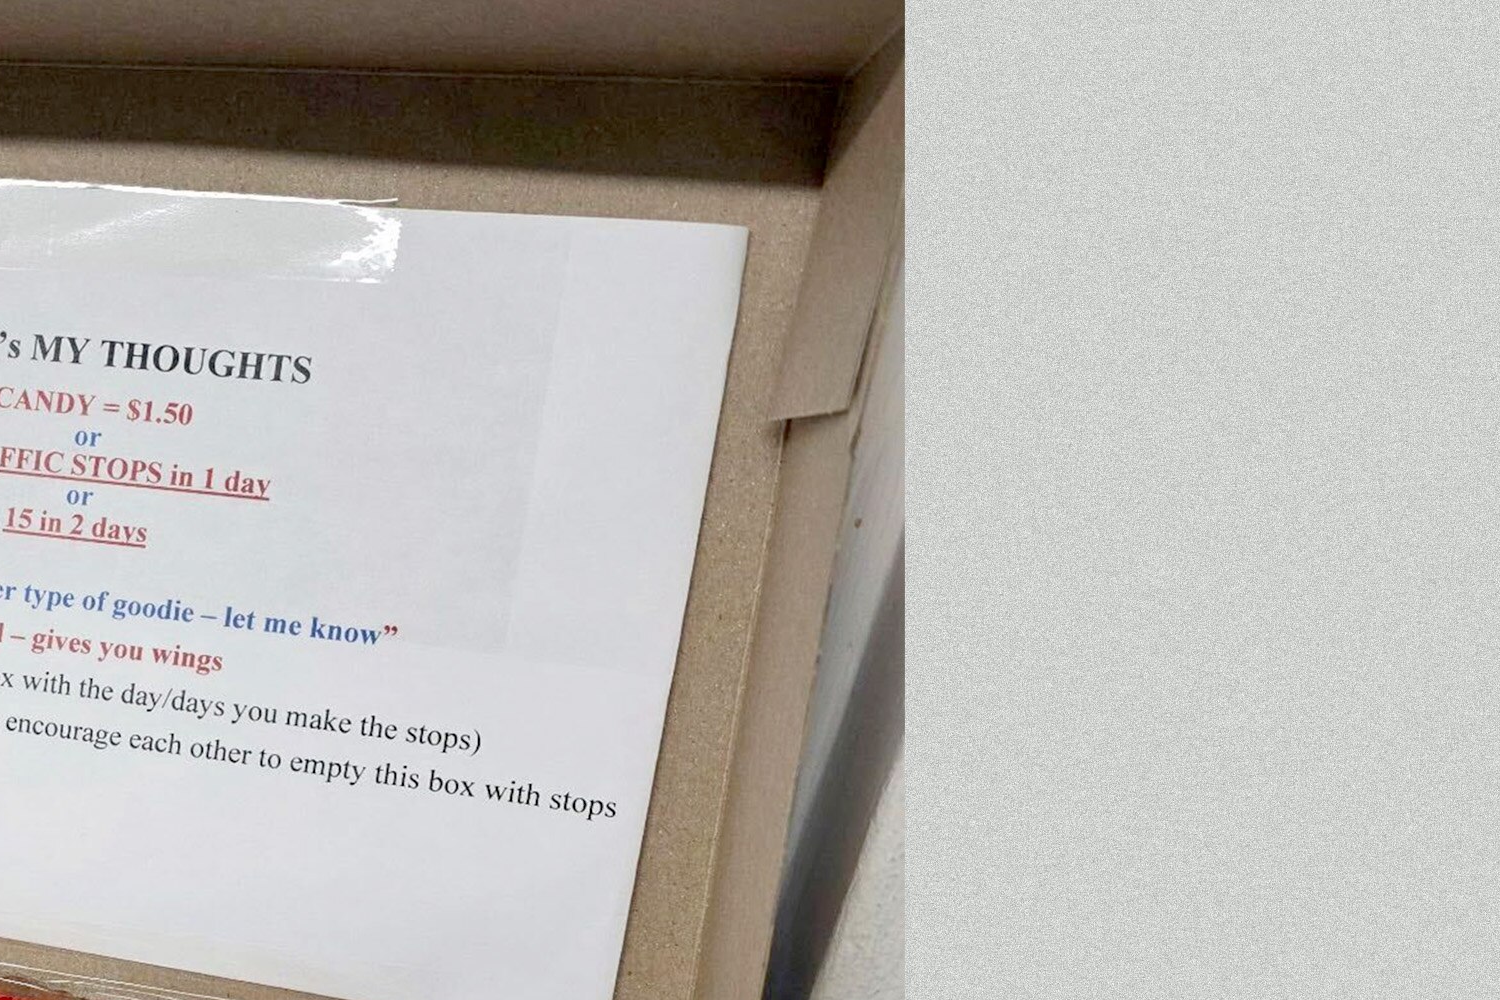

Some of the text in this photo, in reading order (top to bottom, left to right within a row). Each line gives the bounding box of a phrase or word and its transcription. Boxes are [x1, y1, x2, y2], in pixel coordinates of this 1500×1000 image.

[30, 333, 91, 365] MY
[100, 339, 313, 385] THOUGHTS
[102, 403, 120, 413] =
[126, 398, 193, 426] $1.50
[74, 430, 103, 447] or
[66, 489, 94, 506] or
[70, 453, 163, 484] STOPS
[169, 464, 193, 488] in
[204, 467, 214, 490] 1
[224, 470, 270, 497] day
[6, 507, 148, 543] 15 in 2 days
[24, 584, 75, 612] type
[81, 590, 110, 612] of
[111, 598, 195, 623] goodie
[223, 606, 256, 631] let
[263, 617, 302, 637] me
[30, 628, 92, 655] gives
[97, 641, 144, 662] you
[152, 644, 223, 676] wings
[22, 671, 71, 696] with
[79, 677, 114, 702] the
[120, 682, 225, 720] day/days
[230, 703, 278, 725] you
[284, 708, 353, 734] make
[360, 714, 398, 741] the
[405, 724, 482, 757] stops)
[5, 716, 122, 750] encourage
[129, 732, 182, 756] each
[189, 738, 253, 766] other
[259, 749, 282, 770] to
[289, 756, 367, 787] empty
[375, 762, 420, 790] this
[428, 769, 475, 798] box
[485, 780, 541, 808] with
[548, 791, 617, 822] stops
